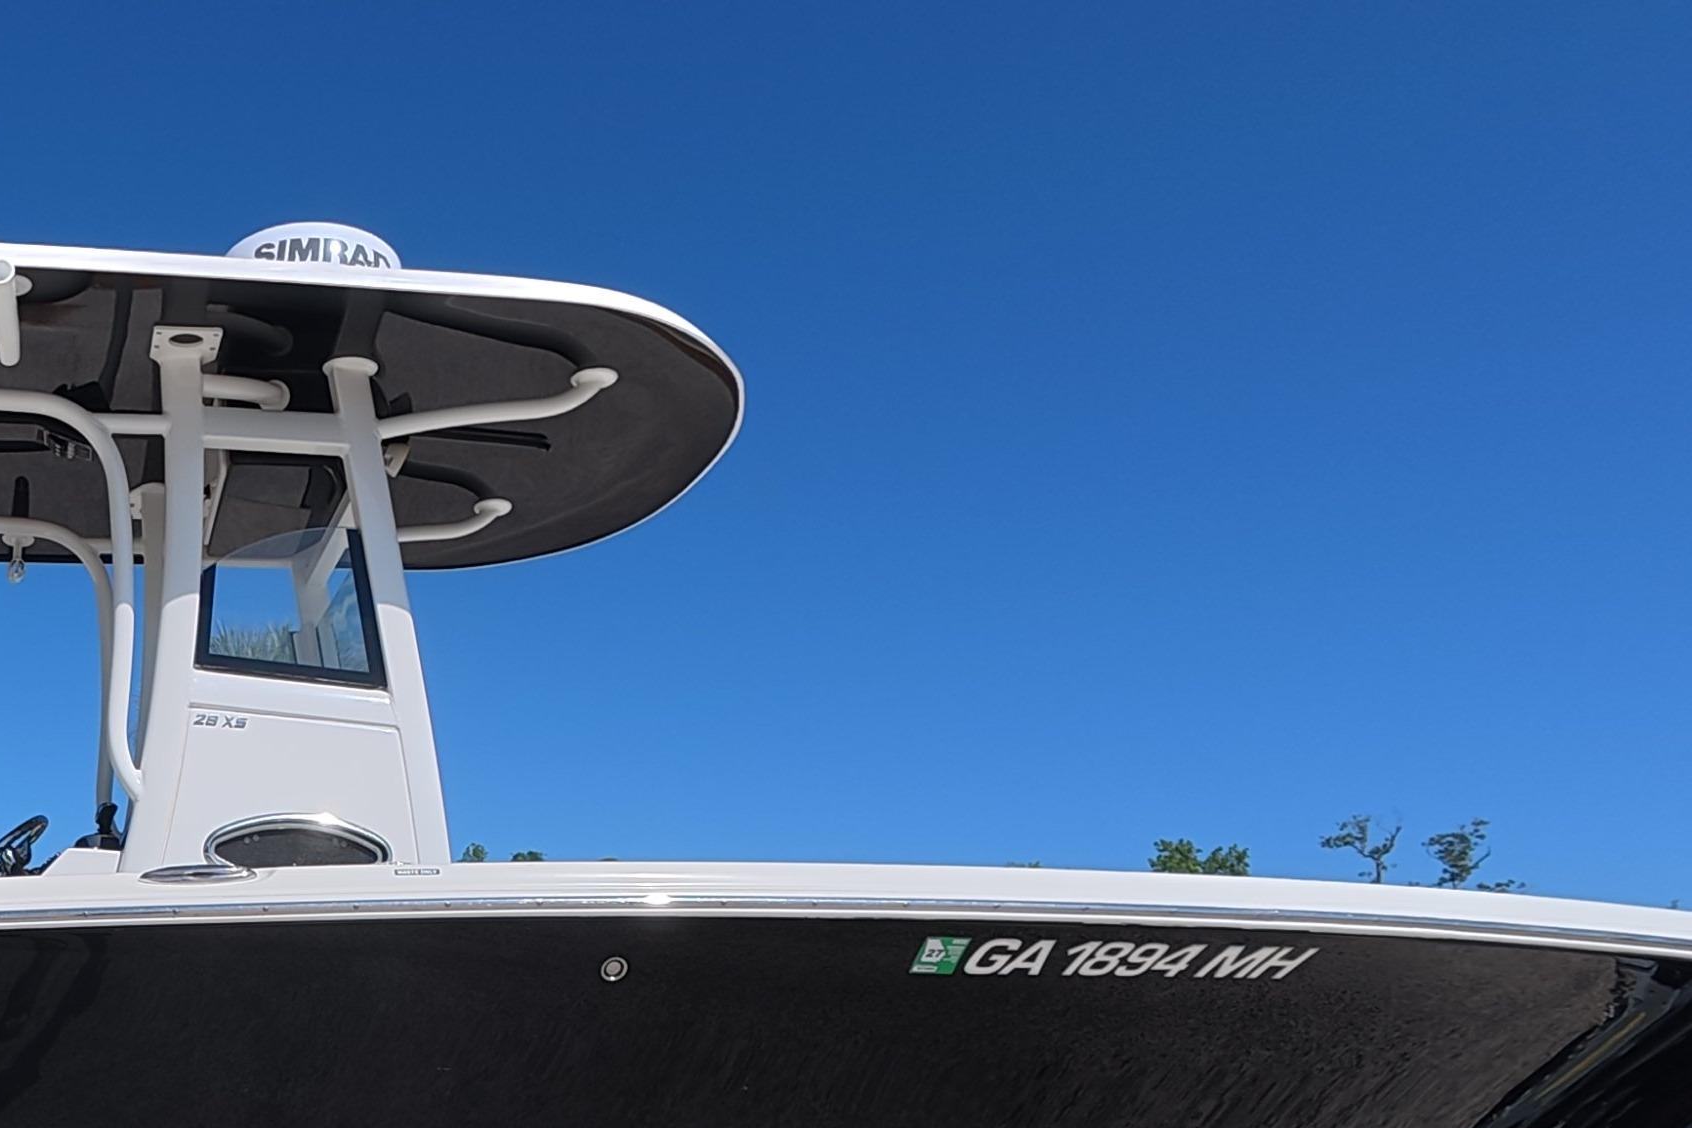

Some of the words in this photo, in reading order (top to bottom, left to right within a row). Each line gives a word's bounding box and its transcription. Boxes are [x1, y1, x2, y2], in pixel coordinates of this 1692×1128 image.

[193, 714, 218, 727] 28
[221, 715, 248, 729] XS
[925, 948, 944, 958] 27
[964, 938, 1057, 976] GA
[1062, 941, 1207, 977] 1894
[1194, 945, 1320, 980] MH
